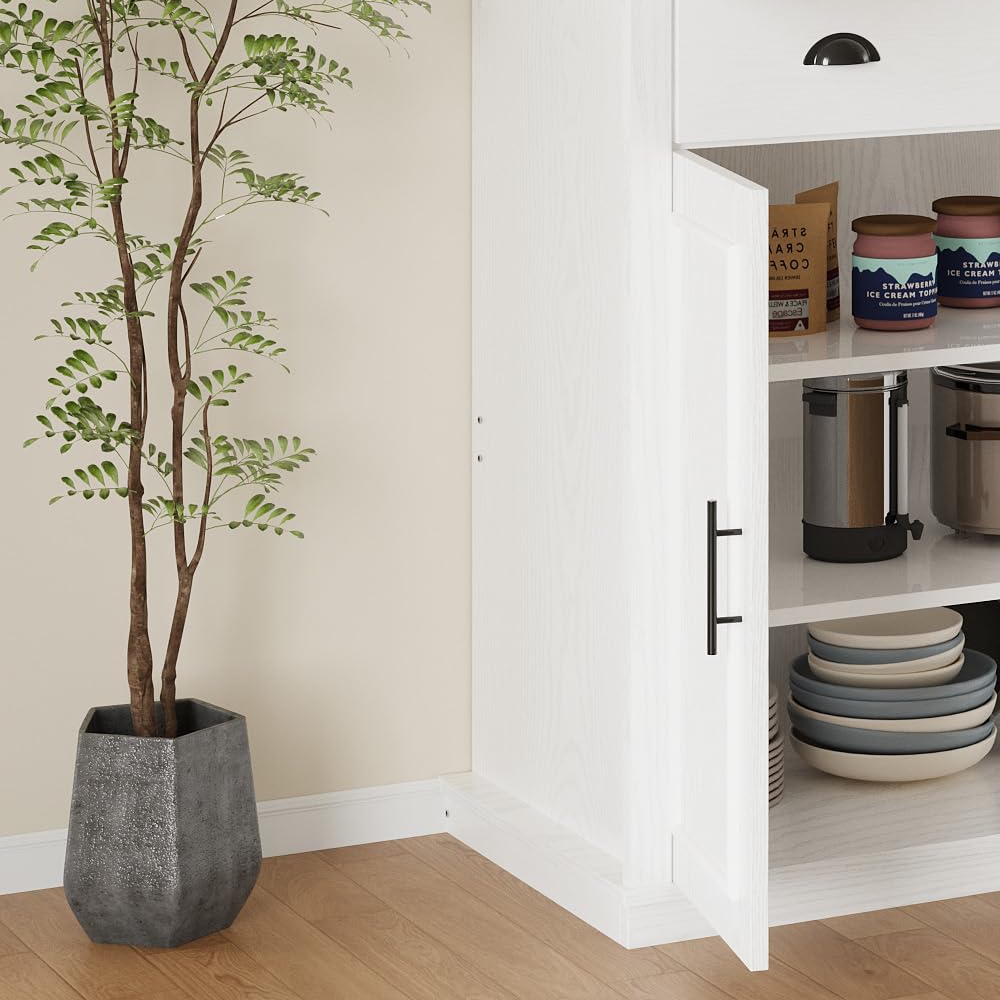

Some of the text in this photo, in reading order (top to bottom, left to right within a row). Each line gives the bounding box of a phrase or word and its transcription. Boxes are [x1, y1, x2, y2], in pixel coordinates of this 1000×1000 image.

[947, 269, 960, 277] ICE
[866, 290, 880, 299] ICE
[884, 291, 916, 299] CREAM
